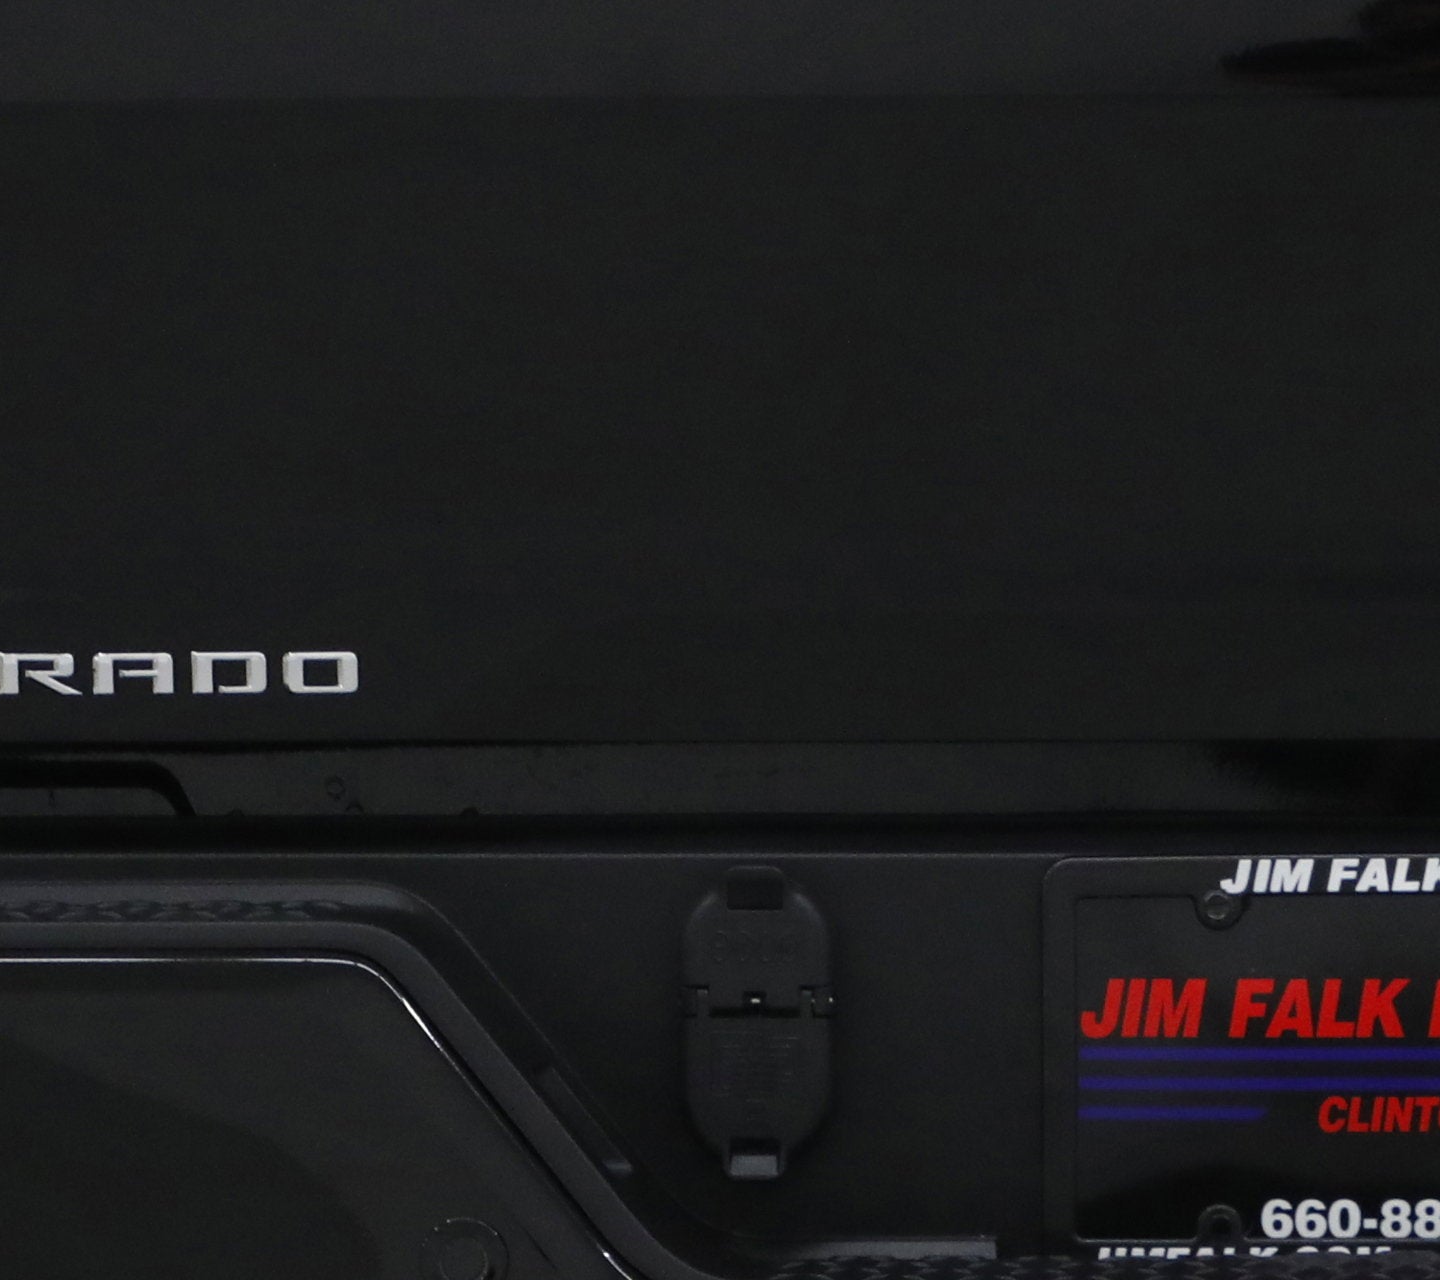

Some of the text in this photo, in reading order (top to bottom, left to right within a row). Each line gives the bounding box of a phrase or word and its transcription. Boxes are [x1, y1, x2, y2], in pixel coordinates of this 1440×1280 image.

[1219, 856, 1313, 894] JIM
[1080, 977, 1208, 1040] JIM
[1228, 977, 1411, 1039] FALK
